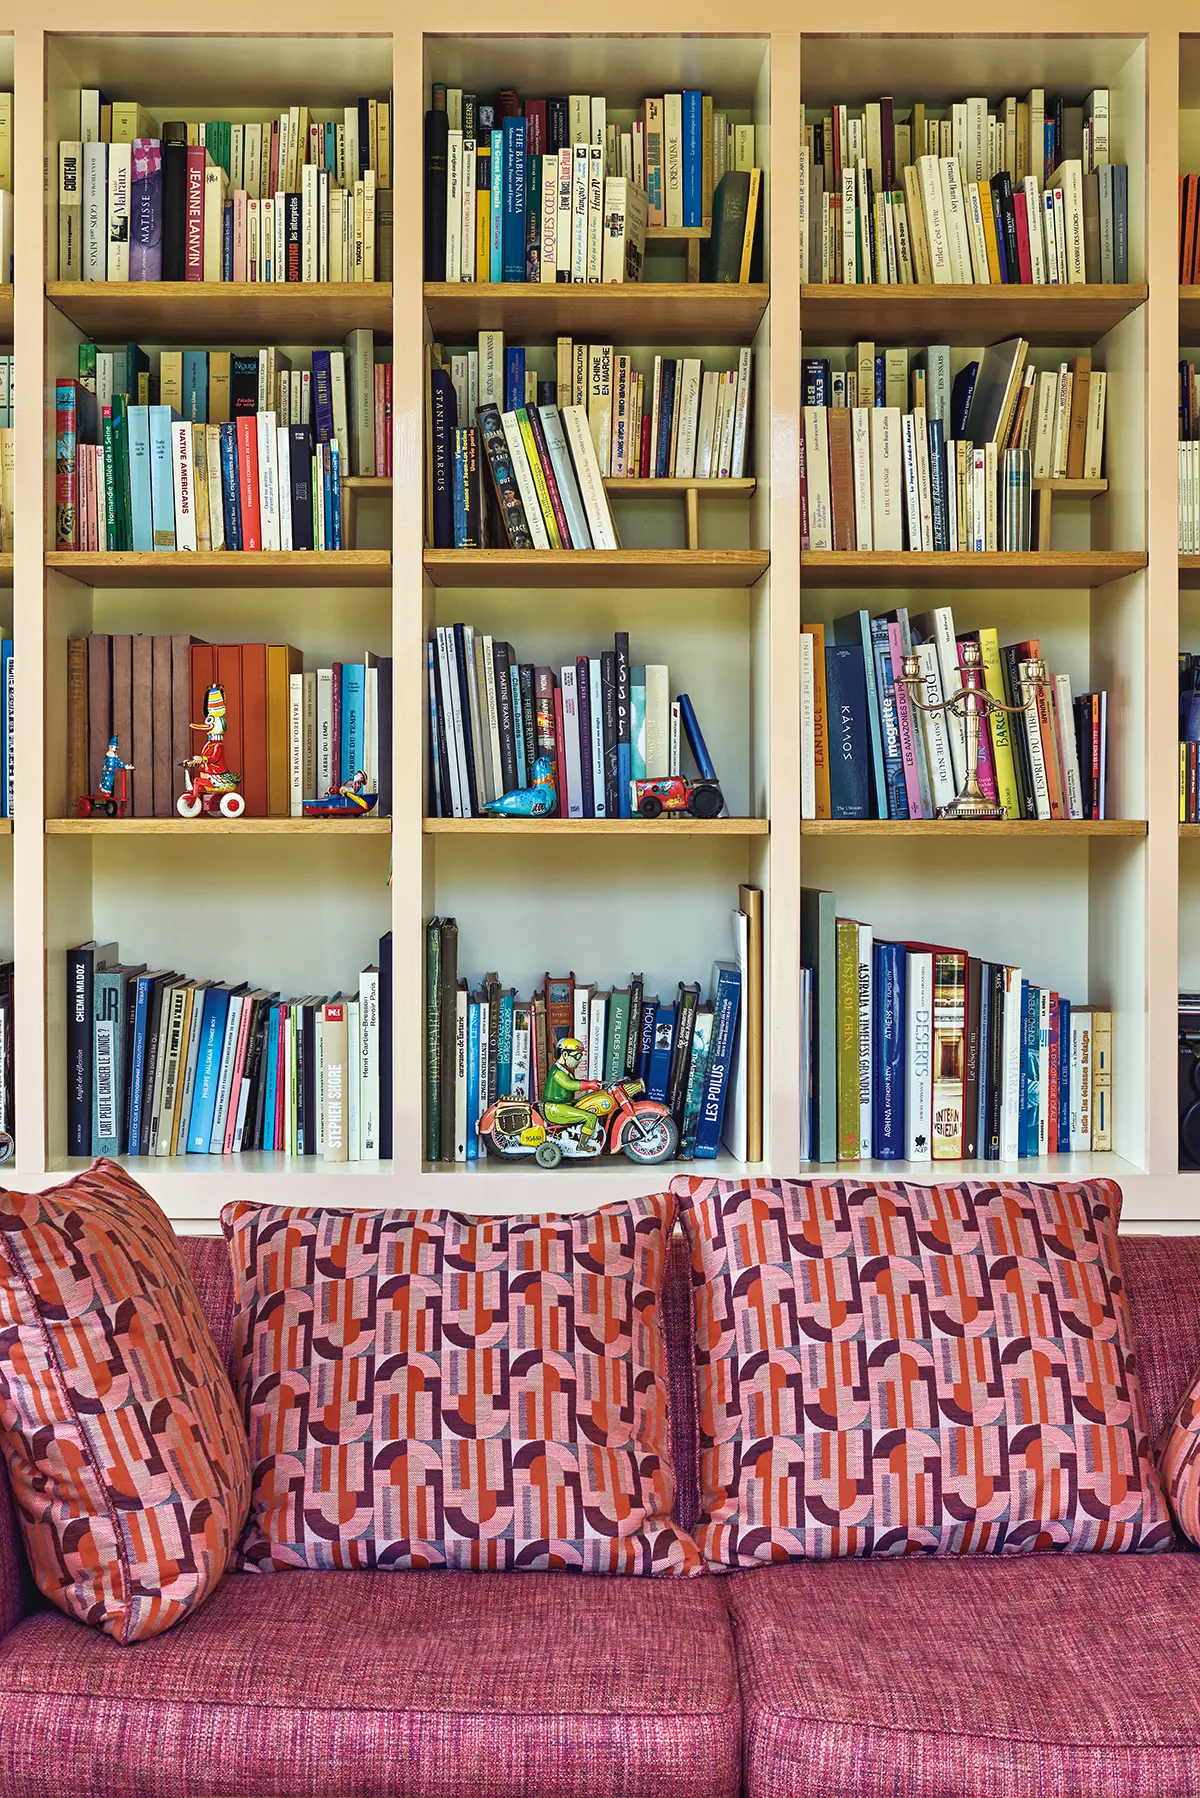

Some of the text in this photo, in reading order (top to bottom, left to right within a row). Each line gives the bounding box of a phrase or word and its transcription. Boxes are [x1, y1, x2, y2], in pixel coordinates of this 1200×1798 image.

[64, 156, 77, 191] COCTEAU
[516, 126, 524, 214] THE BABURNAMA
[113, 167, 127, 215] Malraux
[845, 176, 853, 202] JESUS
[90, 203, 99, 228] GODS
[141, 195, 150, 243] MATISSE
[189, 168, 201, 267] JEANNE LANVIN
[90, 241, 99, 267] KINGS
[288, 232, 298, 240] les
[543, 217, 556, 264] JACQUES
[898, 222, 910, 262] philo de base
[288, 243, 300, 282] SOYINKA
[592, 356, 601, 396] LA CHINE
[601, 347, 610, 396] EN MARCHE
[617, 357, 627, 368] RED
[436, 389, 445, 492] STANLEY MARCUS
[104, 425, 114, 525] Normandie Vallée de la Seine
[178, 429, 190, 514] NATIVE AMERICANS
[500, 671, 511, 730] MARTINE FRANCK
[803, 680, 811, 695] THE
[899, 692, 907, 705] DU
[348, 709, 357, 736] TEMPS
[803, 697, 811, 727] EARTH
[881, 698, 898, 758] magritte
[901, 705, 912, 751] AMAZONES
[1039, 699, 1048, 724] MUNARI
[321, 721, 330, 740] TEMPS
[321, 743, 330, 752] DU
[348, 737, 357, 748] DU
[814, 708, 825, 770] JEAN LUCE
[1029, 737, 1040, 754] DU
[292, 745, 301, 775] TRAVAIL
[292, 777, 301, 788] UN
[75, 963, 85, 1023] CHEMA MADOZ
[859, 962, 870, 1008] AUSTRALIA
[369, 982, 377, 1027] Revoir Paris
[580, 1000, 589, 1025] Luc Ferry
[98, 1034, 110, 1056] MONDE
[361, 996, 369, 1078] Henri Cartier-Bresson
[611, 1007, 623, 1080] AU FIL DES FLEUV
[642, 1007, 654, 1054] HOKUSAI
[844, 1014, 854, 1050] CHINA
[859, 1017, 870, 1057] TIMELESS
[1080, 1030, 1091, 1064] Sardaigne
[98, 1056, 110, 1065] LE
[967, 1032, 976, 1082] Le désert nu
[76, 1075, 83, 1085] de
[99, 1066, 111, 1095] CHANGER
[704, 1063, 726, 1122] LES POILUS
[99, 1095, 111, 1119] PEUT-IL
[327, 1064, 343, 1149] STEPHEN SHORE
[1080, 1115, 1090, 1134] Sicile
[100, 1119, 112, 1137] L'ART
